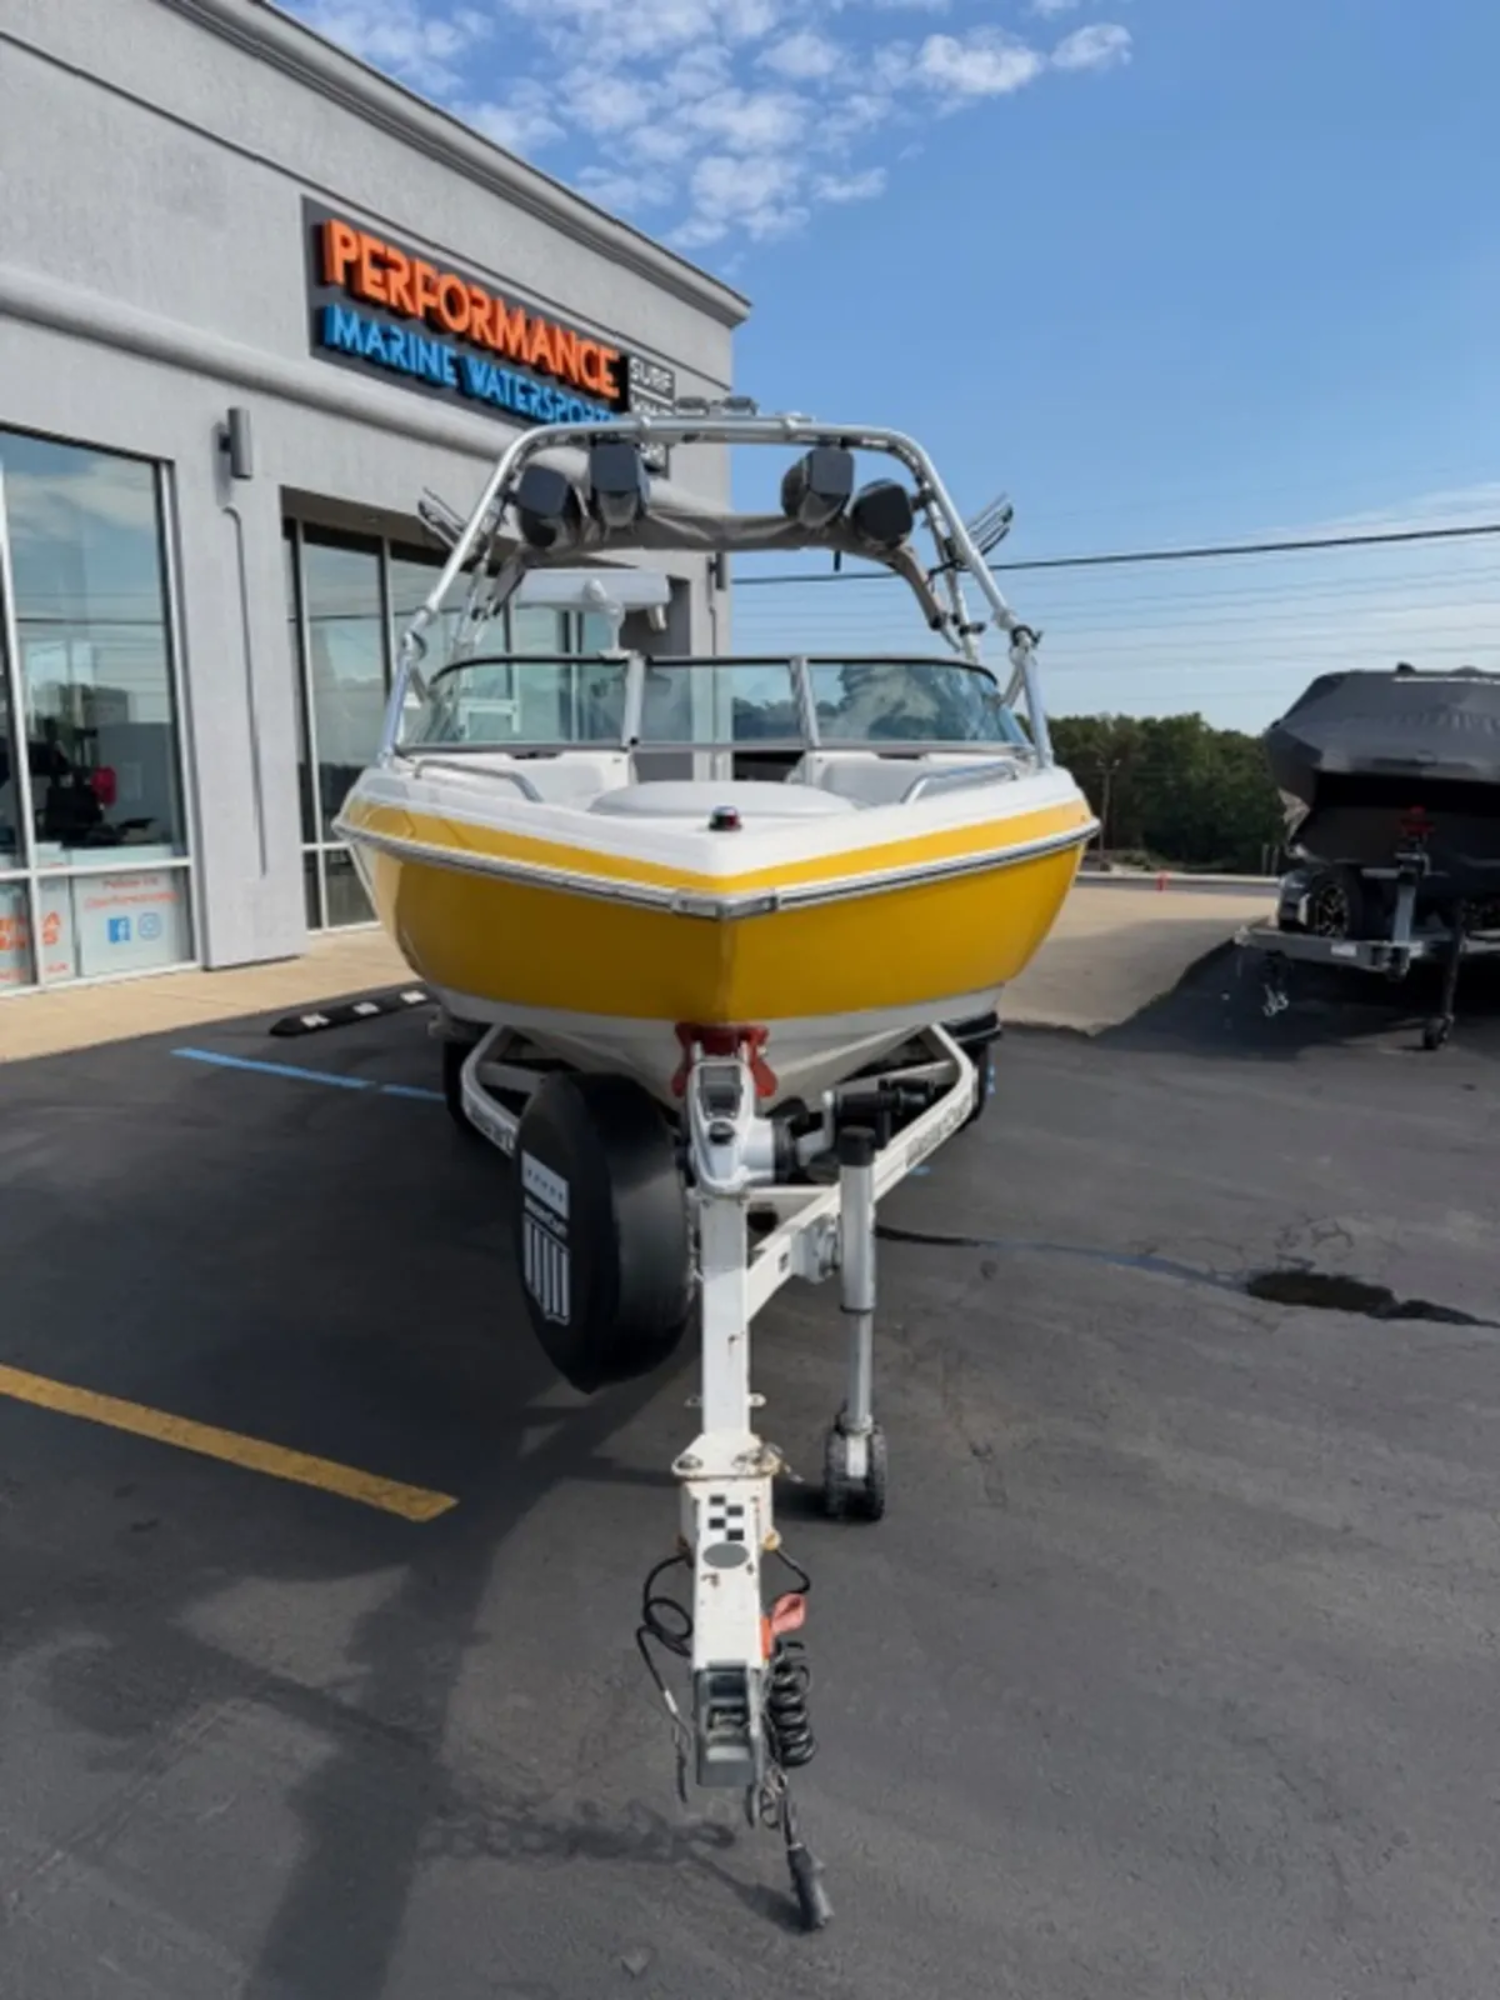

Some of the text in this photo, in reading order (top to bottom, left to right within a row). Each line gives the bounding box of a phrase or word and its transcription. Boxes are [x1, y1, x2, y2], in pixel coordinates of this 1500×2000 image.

[324, 218, 620, 398] PERFORMANCE
[325, 303, 618, 424] MARINE WATERSPORT
